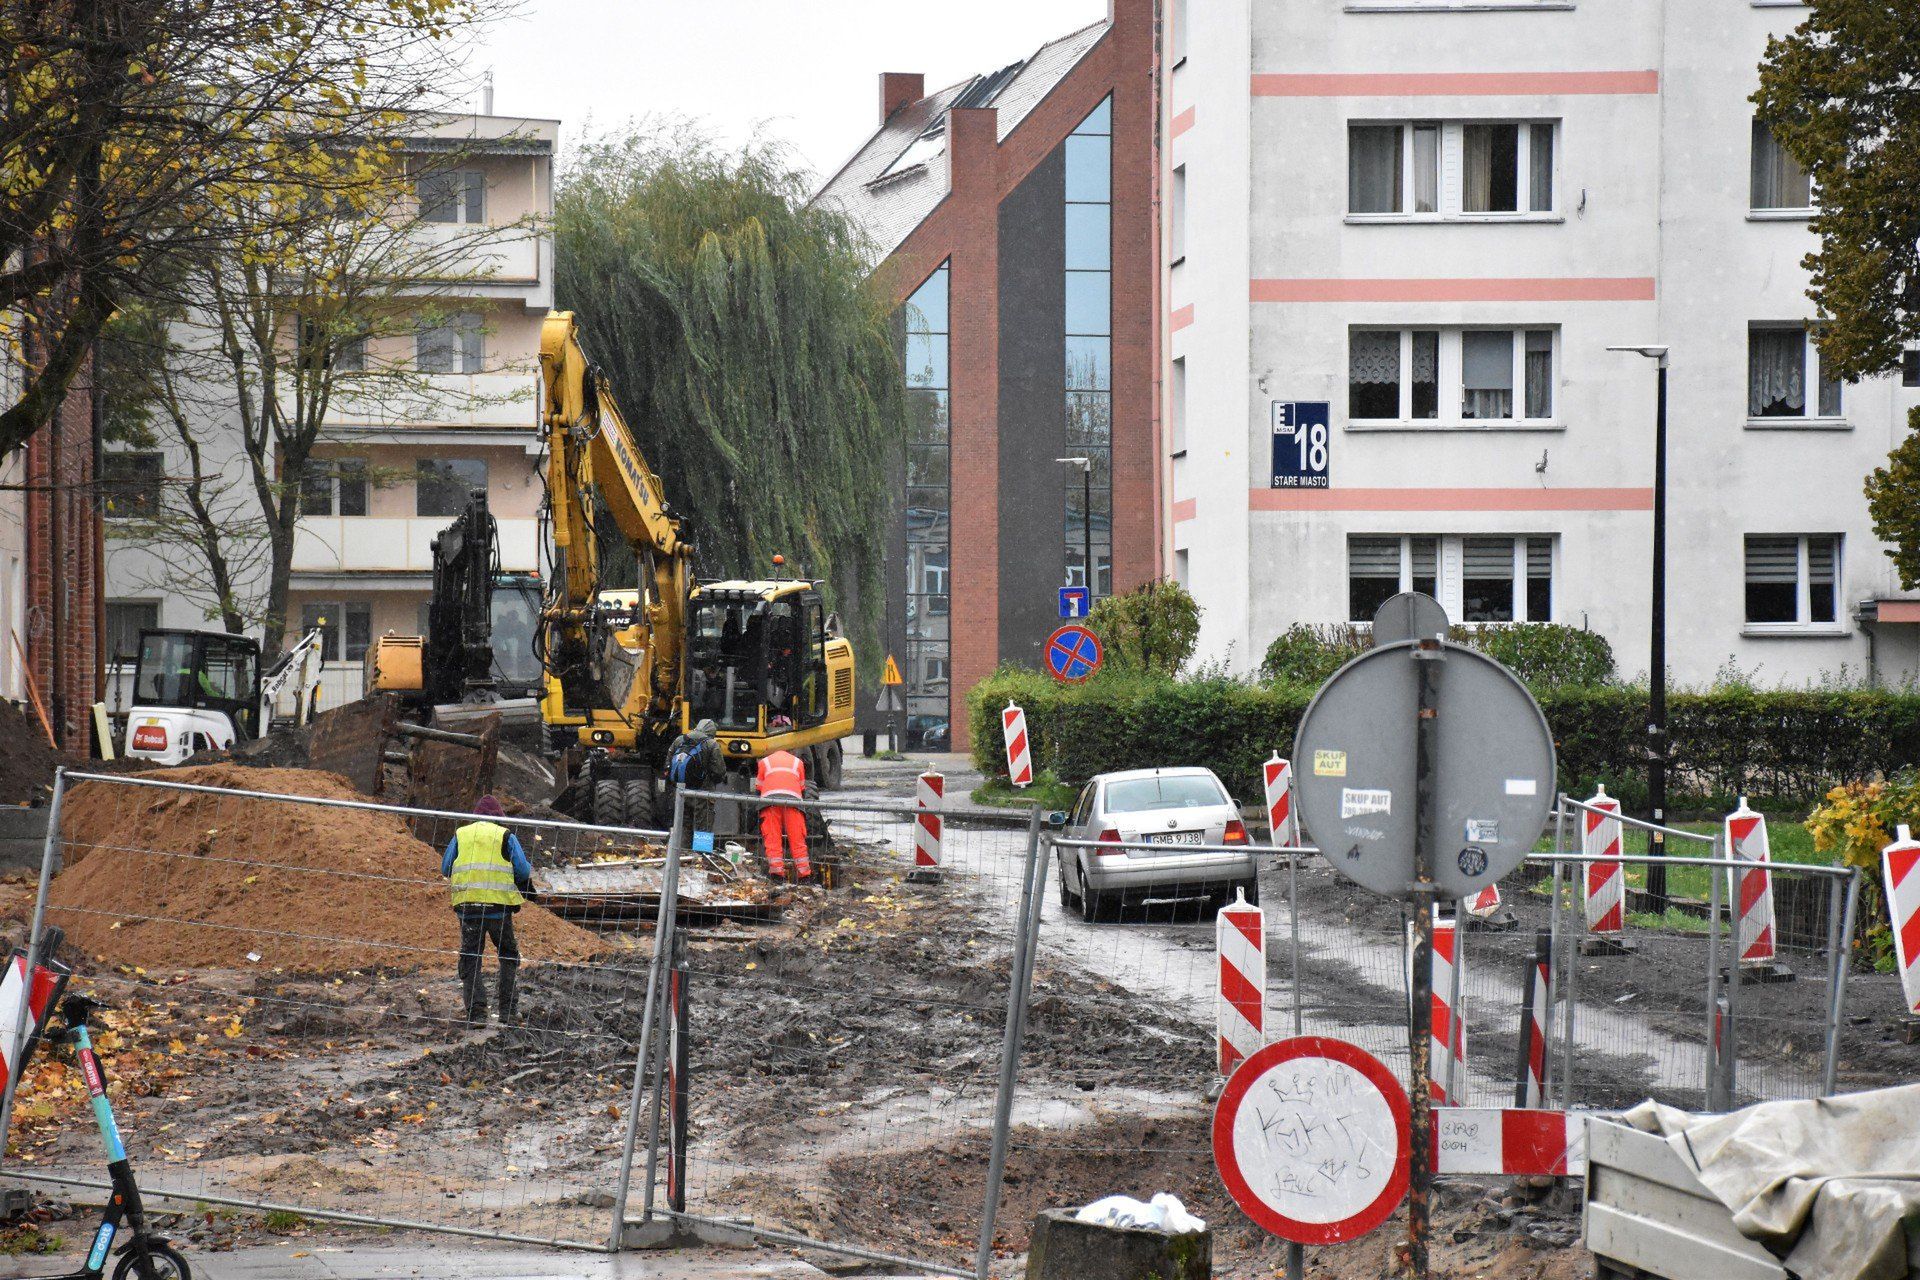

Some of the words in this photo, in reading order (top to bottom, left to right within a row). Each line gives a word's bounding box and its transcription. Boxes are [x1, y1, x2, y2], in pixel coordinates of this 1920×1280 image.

[1294, 423, 1327, 471] 18
[616, 437, 649, 506] KOMATSU
[1274, 476, 1298, 486] STARE
[1300, 476, 1327, 486] MIASTO
[1315, 752, 1345, 760] SKUP
[1320, 760, 1341, 768] AUT
[1345, 793, 1370, 804] SKUP
[1371, 795, 1389, 805] AUT
[1152, 835, 1173, 844] GMB
